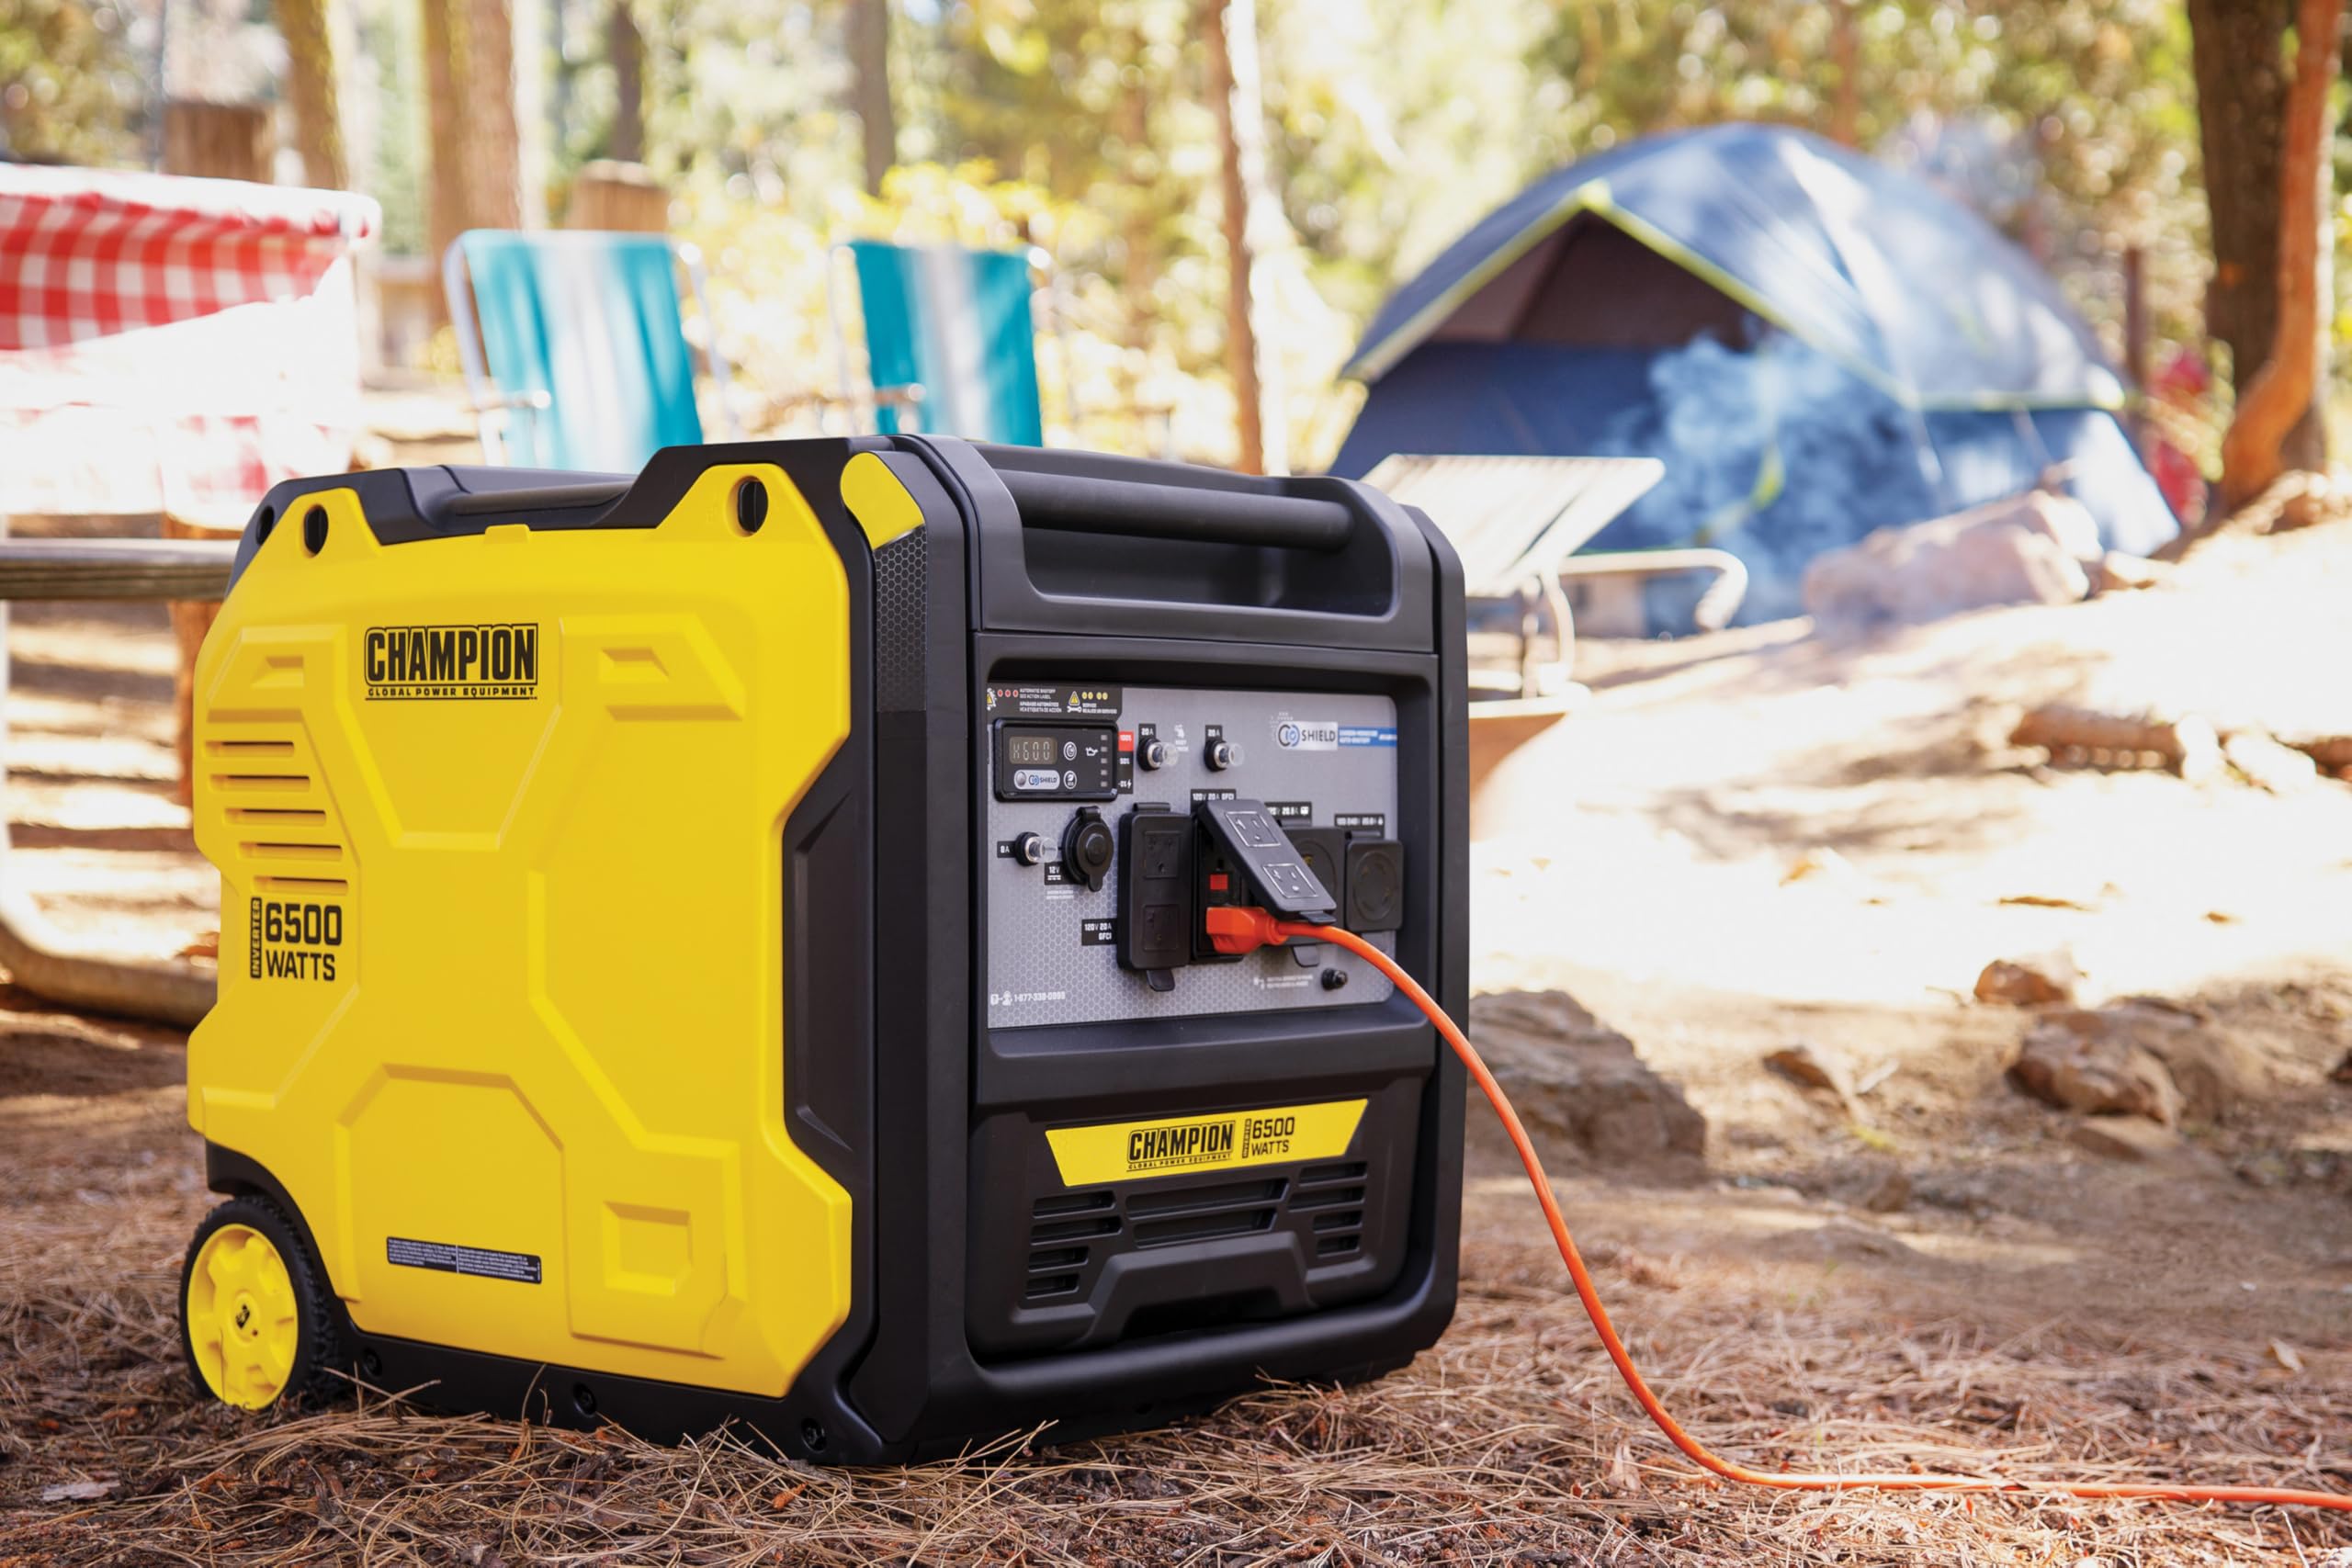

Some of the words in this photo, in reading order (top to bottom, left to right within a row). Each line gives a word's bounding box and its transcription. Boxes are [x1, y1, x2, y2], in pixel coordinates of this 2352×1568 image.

[367, 627, 536, 682] CHAMPION
[368, 688, 411, 696] GLOBAL
[416, 687, 457, 696] POWER
[463, 687, 535, 697] EQUIPMENT
[1301, 729, 1336, 742] SHIELD
[251, 897, 261, 977] INVERTER
[266, 902, 342, 946] 6500
[266, 950, 335, 981] WATTS
[1252, 1117, 1295, 1139] 6500
[1129, 1122, 1234, 1161] CHAMPION
[1251, 1140, 1289, 1156] WATTS
[1128, 1161, 1157, 1169] GLOBAL
[1159, 1157, 1185, 1166] POWER
[1189, 1152, 1232, 1163] EQUIPMENT
